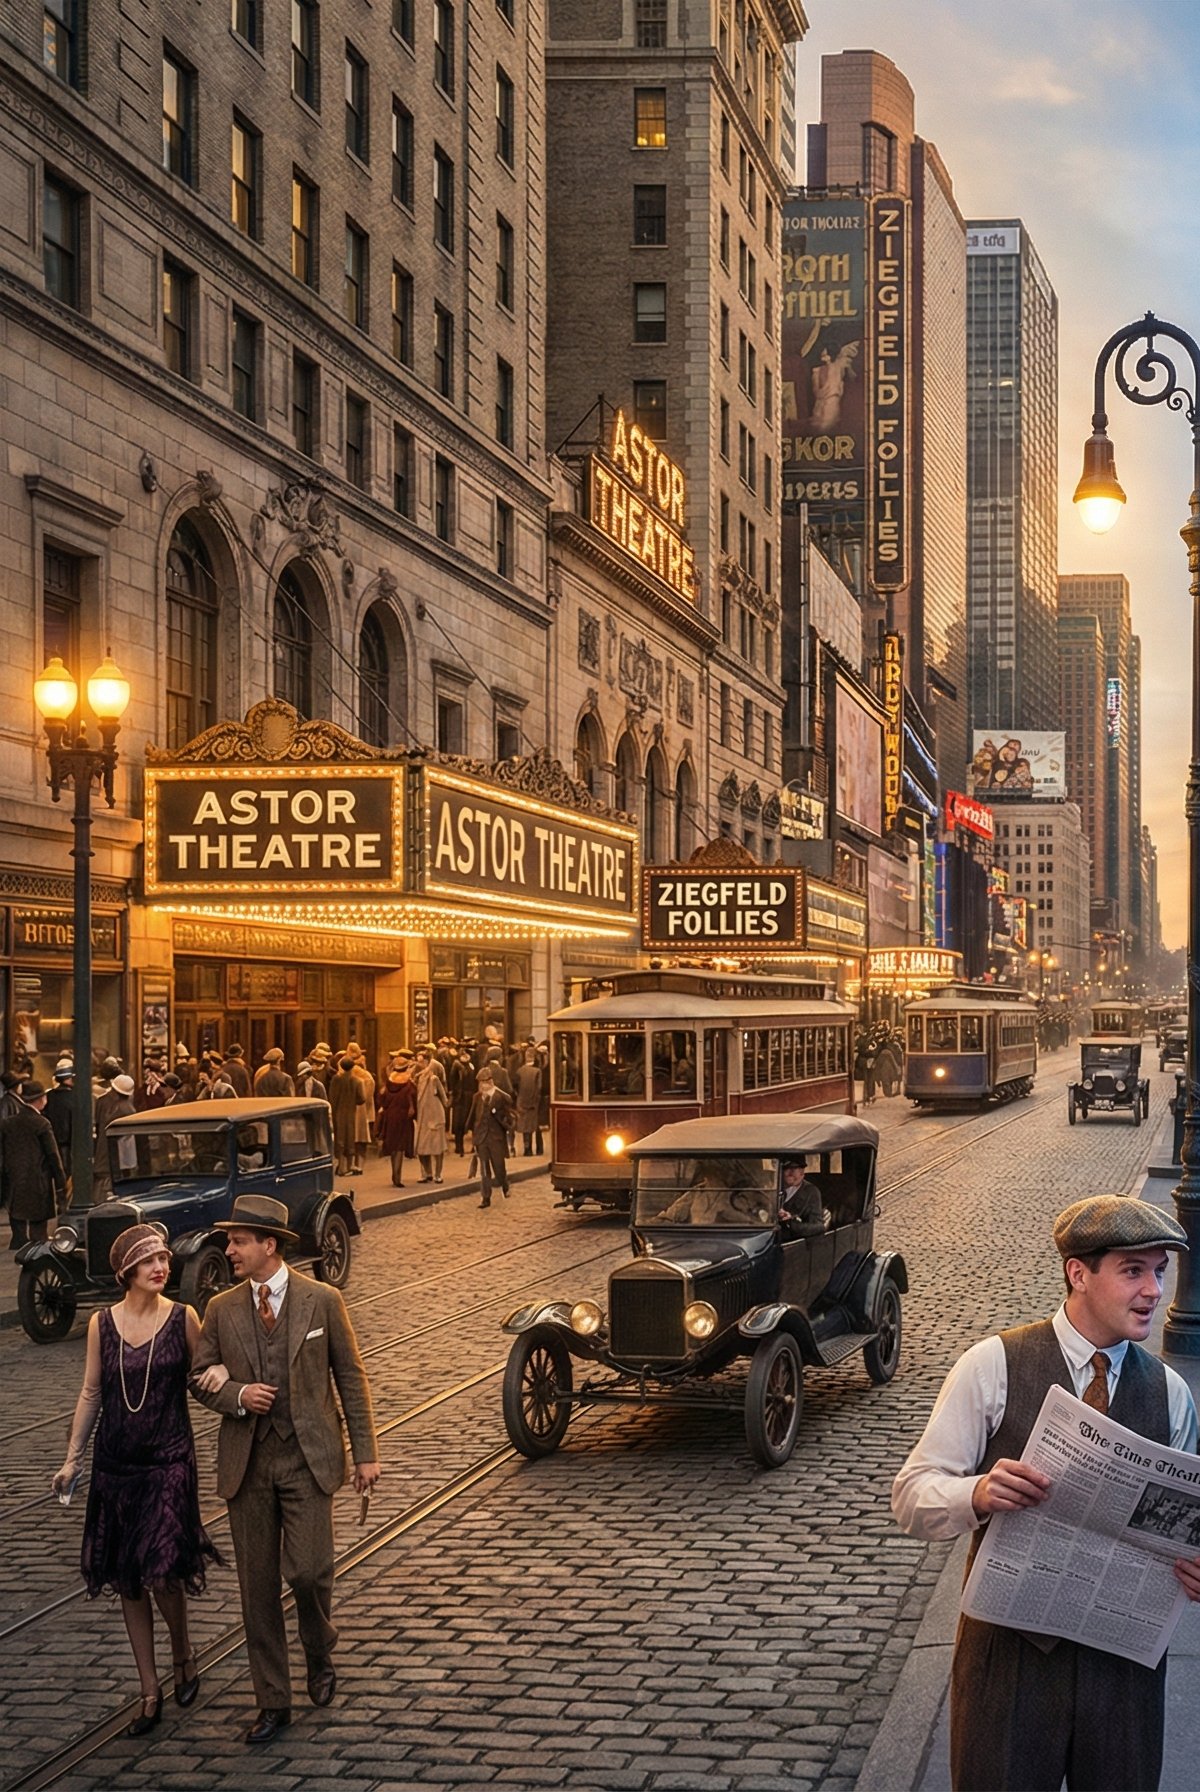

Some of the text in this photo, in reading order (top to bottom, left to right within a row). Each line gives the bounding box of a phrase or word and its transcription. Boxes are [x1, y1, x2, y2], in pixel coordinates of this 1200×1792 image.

[878, 209, 900, 562] ZIEGFELD FOLLIES
[612, 408, 685, 528] ASTOR
[595, 466, 696, 600] THEATRE
[193, 790, 356, 825] ASTOR
[169, 834, 381, 869] THEATRE
[435, 801, 626, 902] ASTOR THEATRE
[658, 881, 787, 907] ZIEGFELD
[668, 910, 779, 936] FOLLIES
